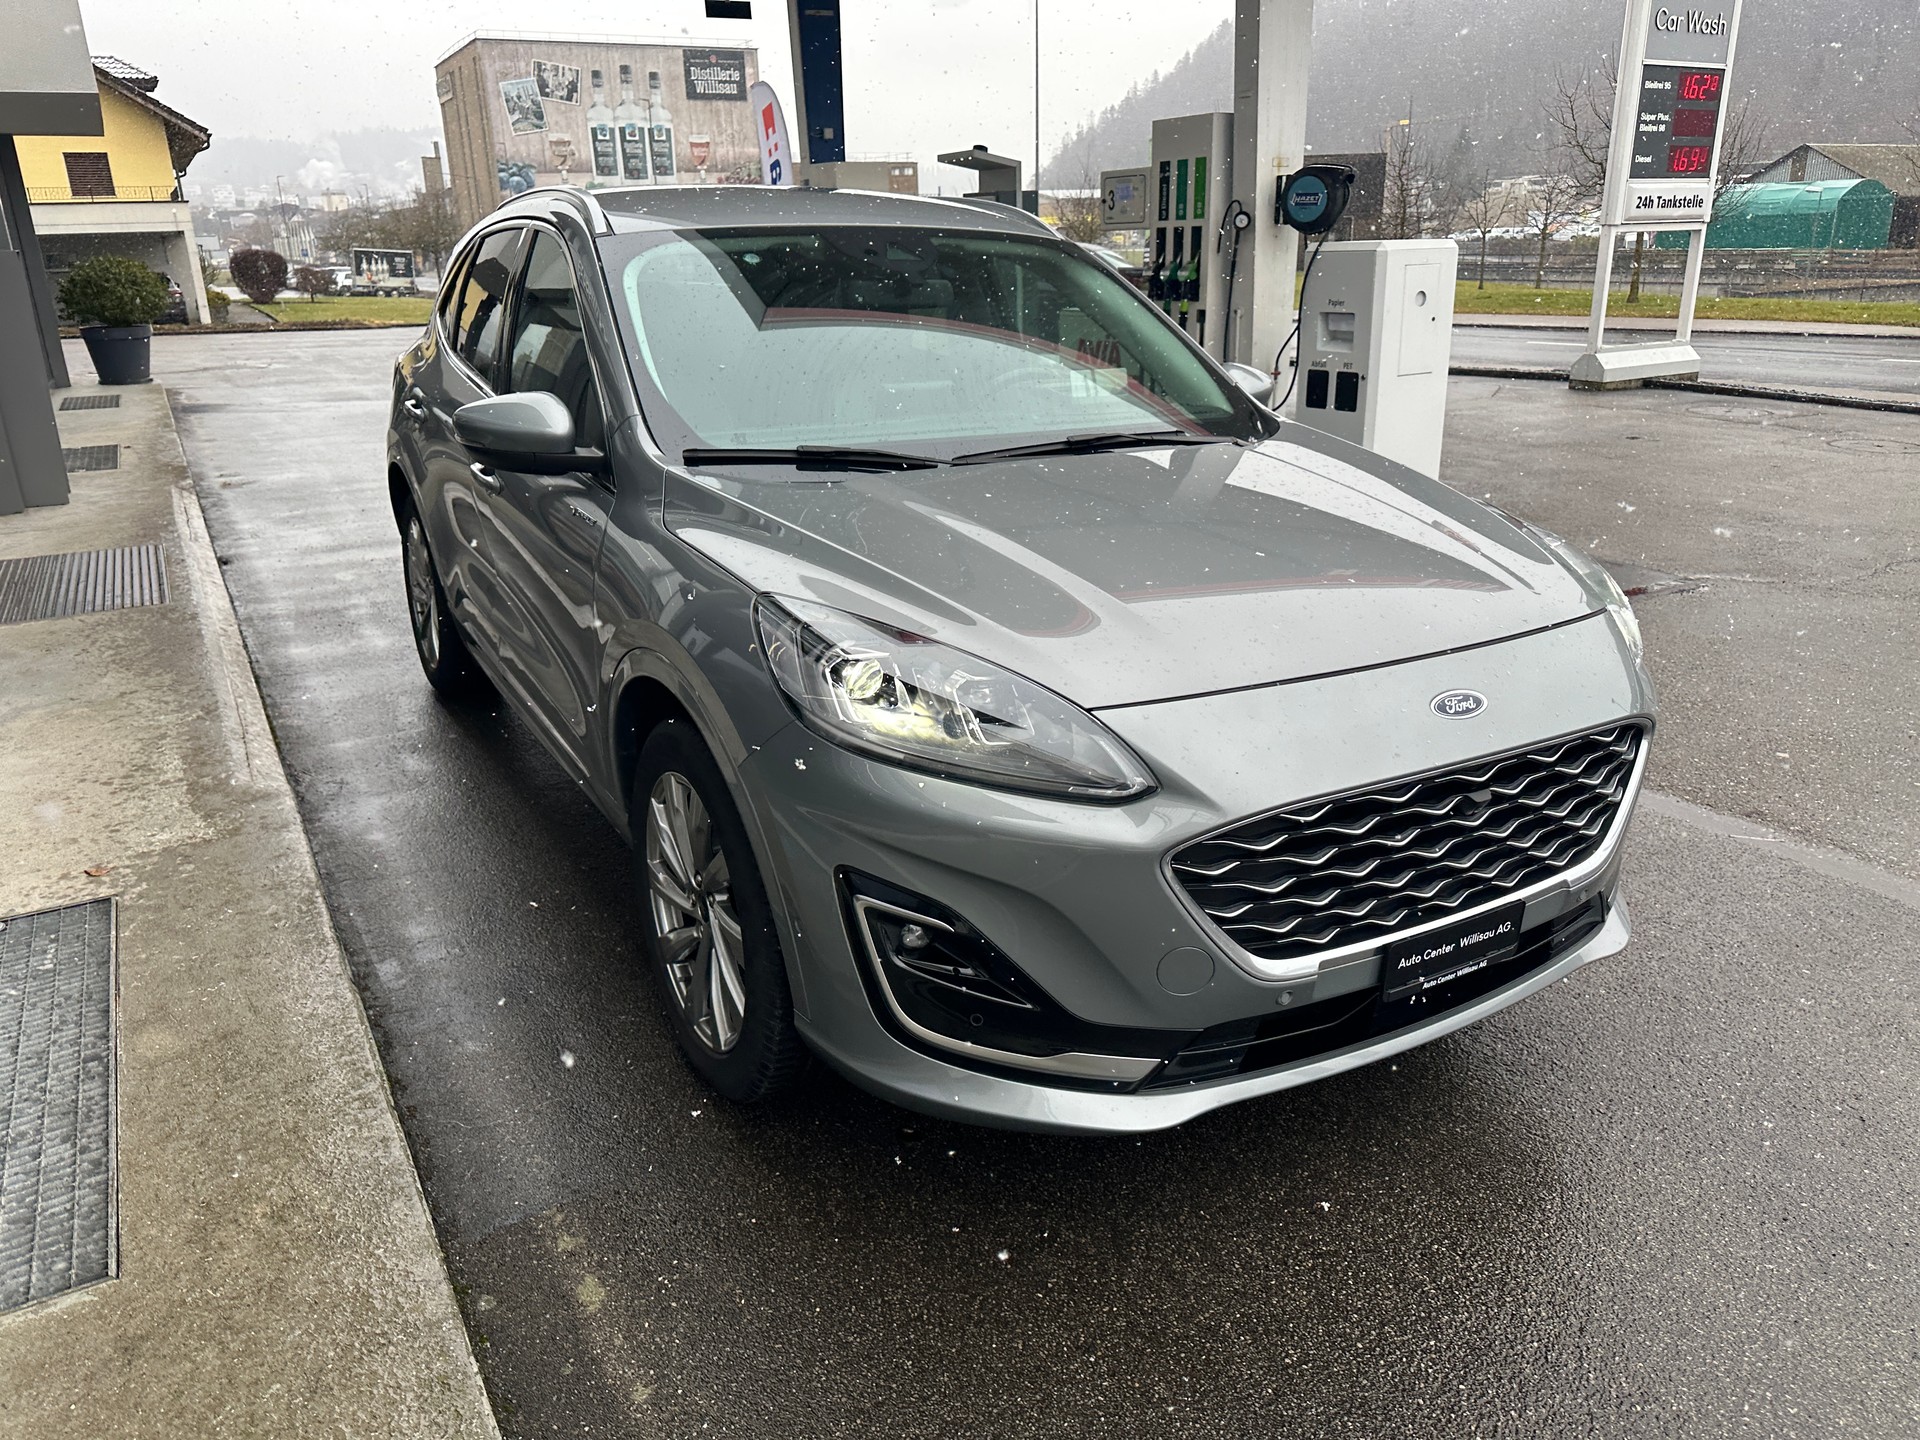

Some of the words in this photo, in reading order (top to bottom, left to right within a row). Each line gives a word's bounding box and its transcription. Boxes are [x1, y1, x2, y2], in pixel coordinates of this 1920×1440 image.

[1655, 7, 1684, 31] Car
[1687, 9, 1727, 35] Wash
[690, 67, 740, 81] Distillerie
[694, 80, 738, 94] Willisau
[1635, 154, 1653, 163] Diesel
[1108, 189, 1115, 211] 3
[1635, 195, 1654, 209] 24h
[1328, 298, 1345, 308] Papier
[1343, 362, 1353, 370] PET
[1444, 695, 1477, 714] Ford
[1397, 954, 1421, 970] Auto
[1423, 943, 1456, 960] Center
[1460, 929, 1496, 948] Willisau
[1496, 921, 1512, 936] AG
[1422, 979, 1437, 990] Auto
[1437, 972, 1457, 984] Center
[1456, 963, 1479, 977] Willisau
[1478, 960, 1488, 970] AG
